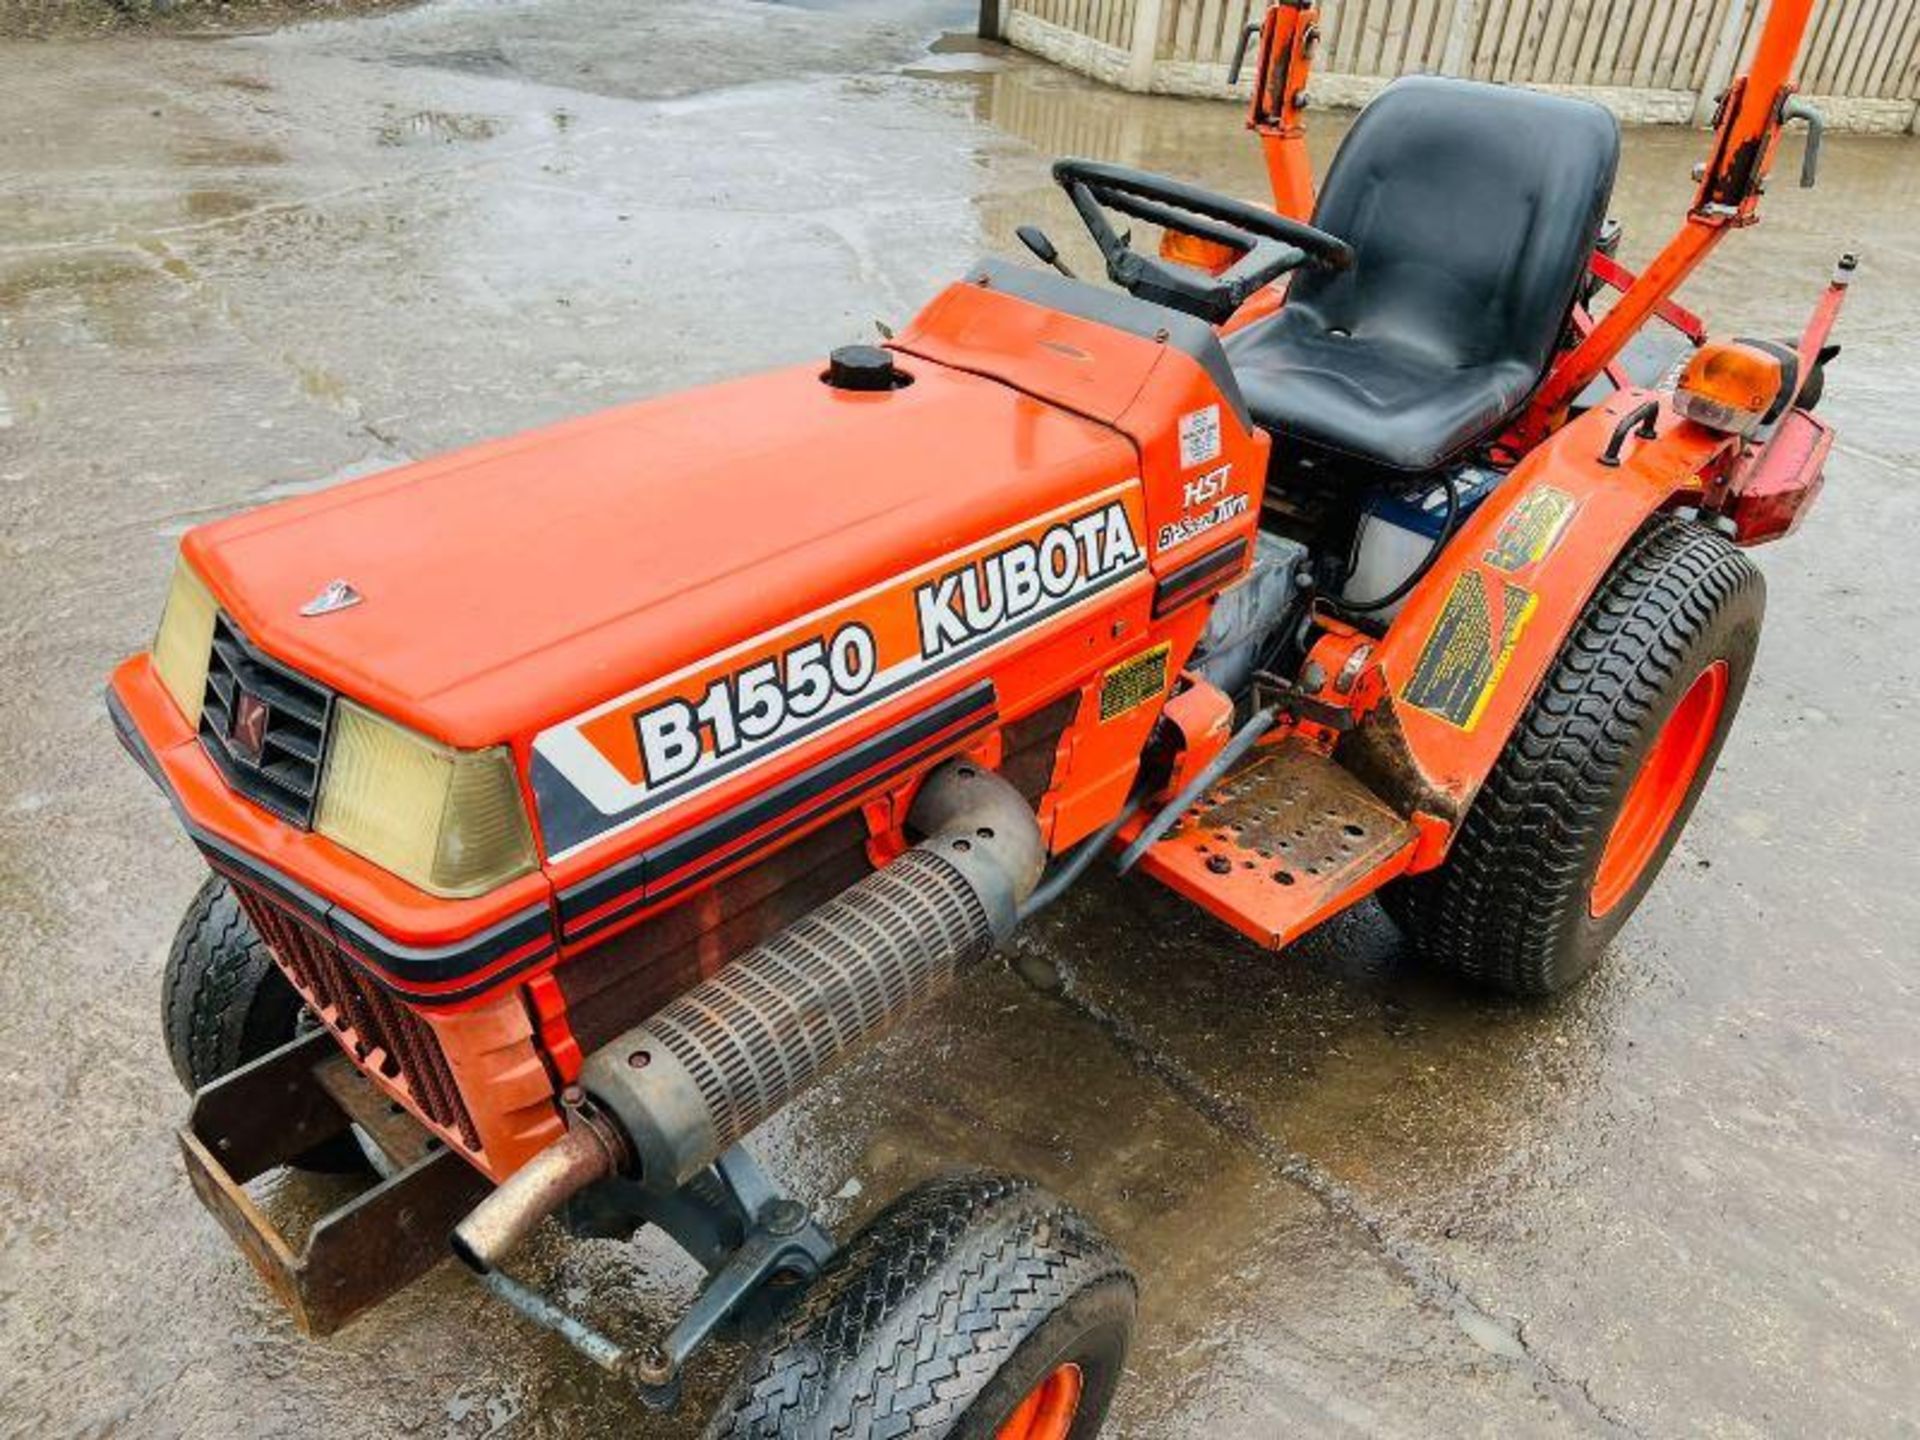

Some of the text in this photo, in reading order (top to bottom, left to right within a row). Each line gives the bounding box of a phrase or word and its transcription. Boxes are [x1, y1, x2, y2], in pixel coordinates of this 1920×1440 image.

[1183, 463, 1232, 507] HST
[634, 500, 1140, 789] B1550 KUBOTA
